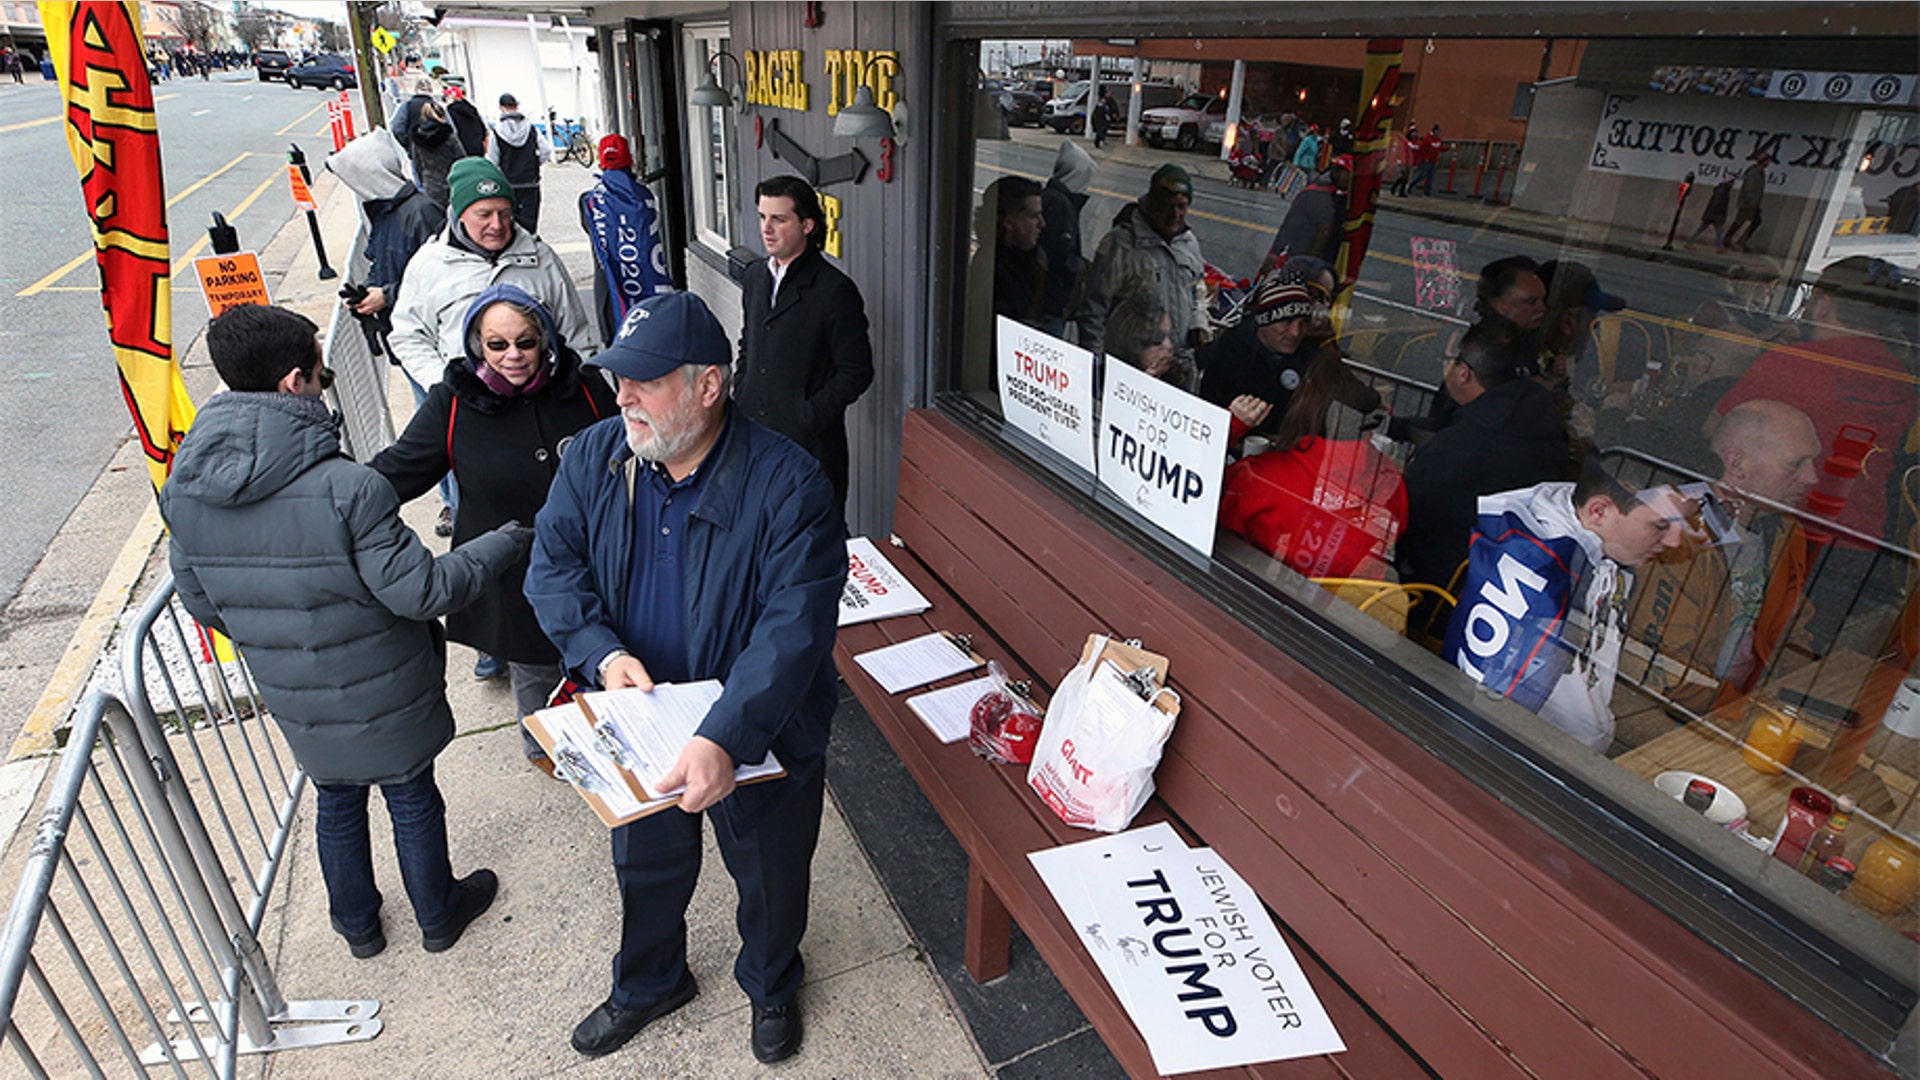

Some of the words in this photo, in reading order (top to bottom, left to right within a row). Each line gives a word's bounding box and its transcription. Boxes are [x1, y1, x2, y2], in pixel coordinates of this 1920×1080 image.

[744, 49, 810, 112] BAGEL
[824, 50, 899, 117] TIME
[876, 137, 895, 183] 3
[205, 271, 258, 287] PARKING
[218, 260, 237, 272] NO
[1014, 351, 1070, 393] TRUMP
[1006, 373, 1029, 391] MOST
[1029, 385, 1082, 421] PRO-ISRAEL
[1007, 387, 1053, 418] PRESIDENT
[1113, 381, 1158, 418] JEWISH
[1161, 405, 1213, 445] VOTER
[1137, 418, 1168, 449] FOR
[1109, 423, 1204, 505] TRUMP
[1126, 868, 1238, 1038] TRUMP
[1195, 916, 1237, 969] FOR
[1196, 865, 1254, 942] JEWISH
[1244, 947, 1302, 1031] VOTER
